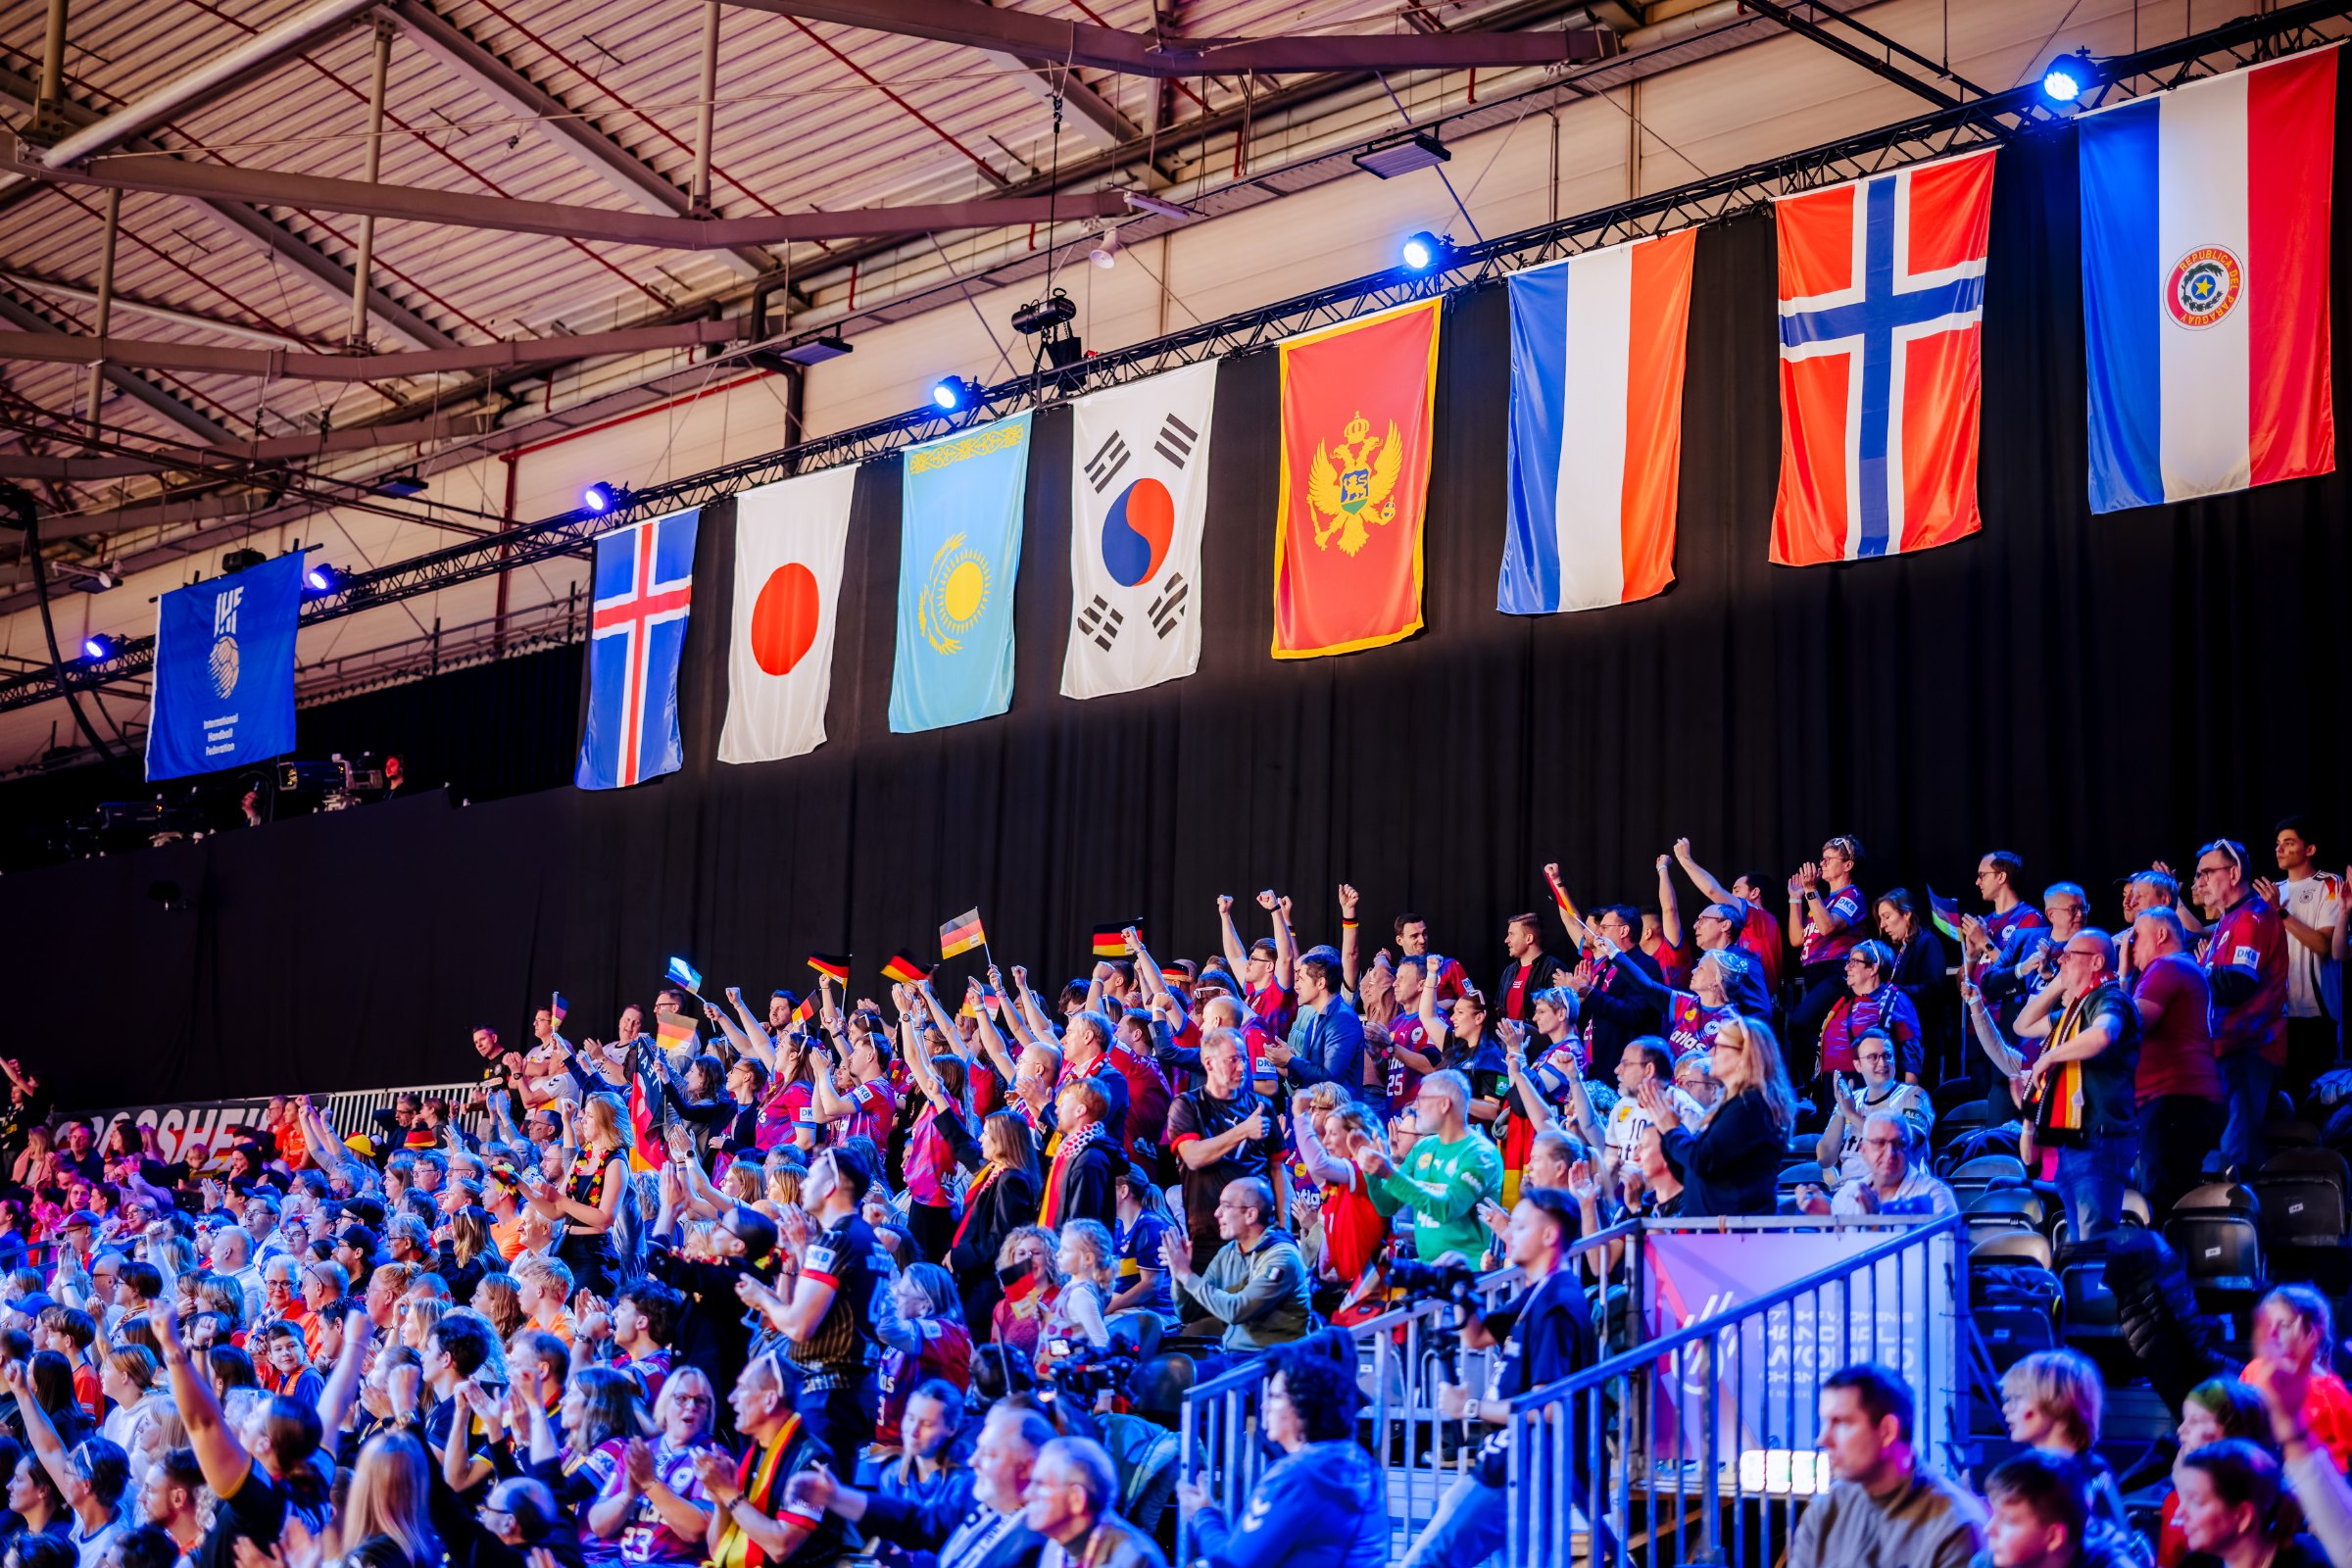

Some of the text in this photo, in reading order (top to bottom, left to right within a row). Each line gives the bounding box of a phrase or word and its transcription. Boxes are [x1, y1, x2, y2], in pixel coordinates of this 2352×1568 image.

[2179, 249, 2240, 326] REPUBLICA DEL PARAGUAY
[203, 712, 238, 730] International
[208, 727, 233, 742] Handball
[206, 742, 235, 756] Federation
[1838, 898, 1856, 911] DKB
[1386, 1073, 1403, 1097] 25
[801, 1108, 813, 1117] DK
[620, 1526, 654, 1562] 23
